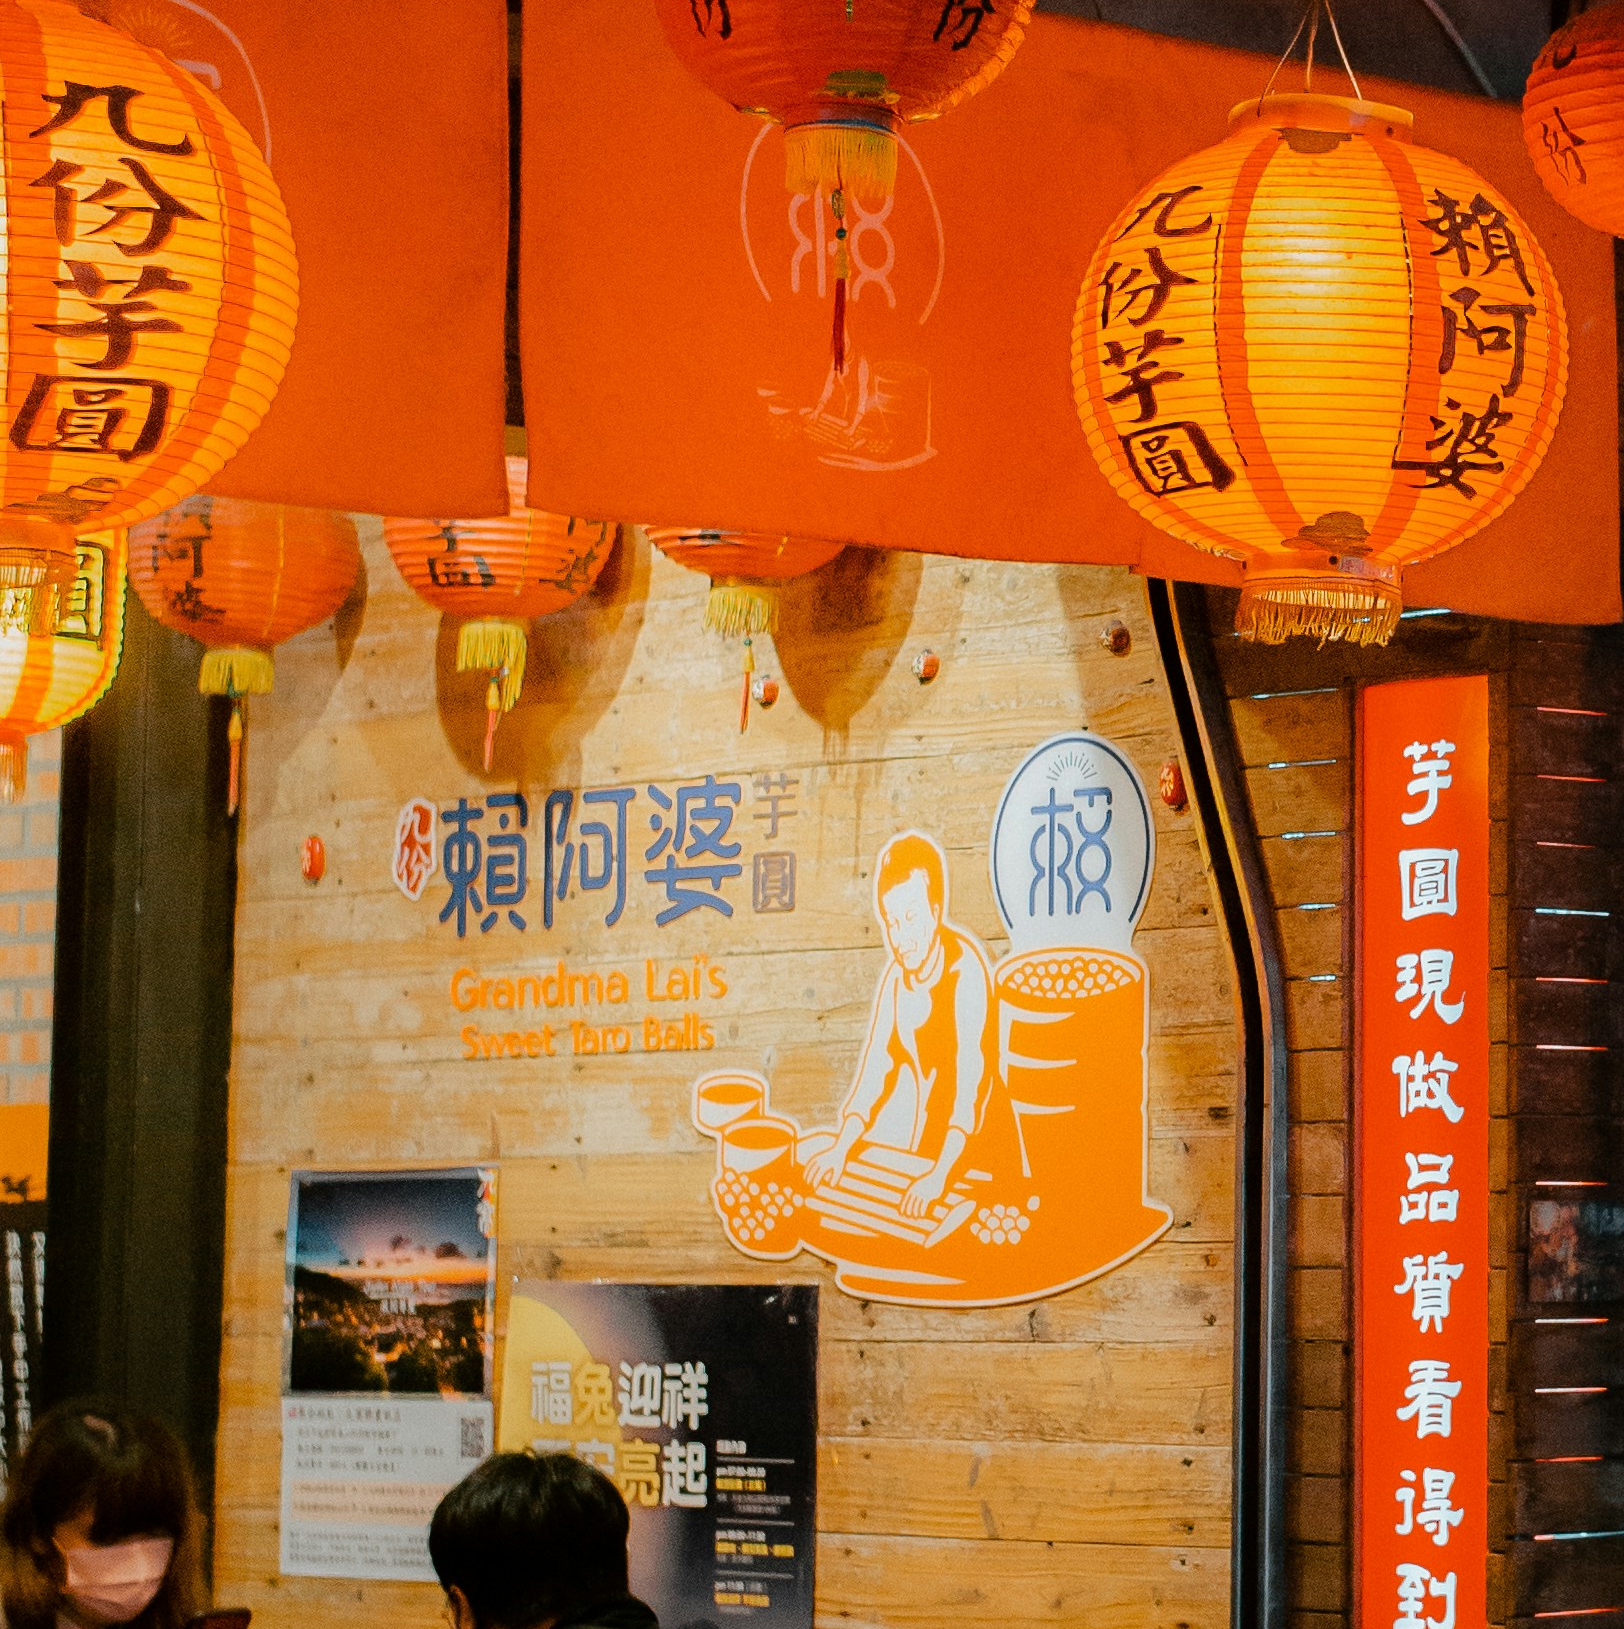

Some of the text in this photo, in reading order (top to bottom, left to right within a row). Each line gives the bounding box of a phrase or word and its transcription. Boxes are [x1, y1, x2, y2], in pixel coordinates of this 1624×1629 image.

[8, 80, 207, 461] 九份芋圓
[1100, 185, 1237, 499] 九份芋圓
[1392, 188, 1537, 501] 賴阿婆
[396, 773, 800, 938] 九份 賴阿婆 芋圓
[451, 954, 728, 1012] Grandma Lai's
[461, 1012, 715, 1060] Sweet Taro Balls
